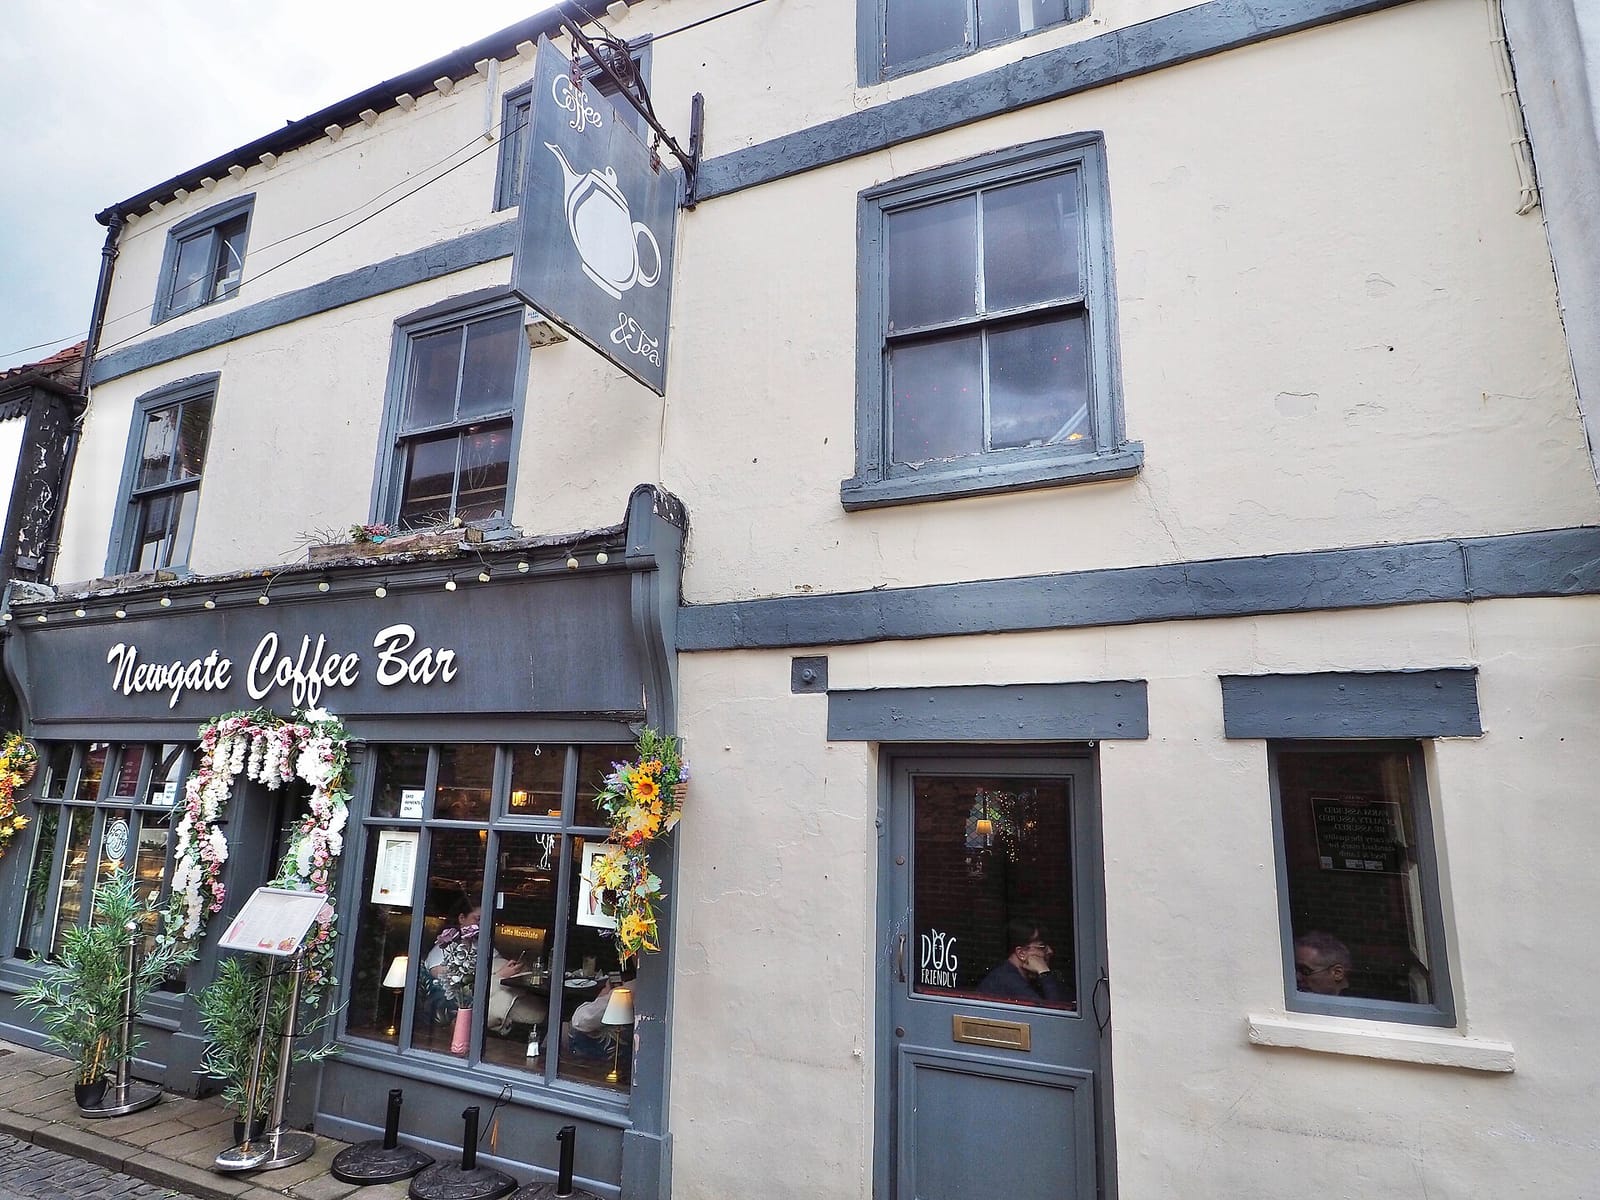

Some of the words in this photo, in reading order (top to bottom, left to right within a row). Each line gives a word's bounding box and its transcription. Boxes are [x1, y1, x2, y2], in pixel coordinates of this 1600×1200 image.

[552, 74, 602, 132] Coffee
[106, 642, 231, 708] Newgate
[246, 631, 360, 710] Coffee
[373, 623, 458, 686] Bar
[921, 928, 957, 971] DOG
[921, 969, 957, 988] FRIENDLY
